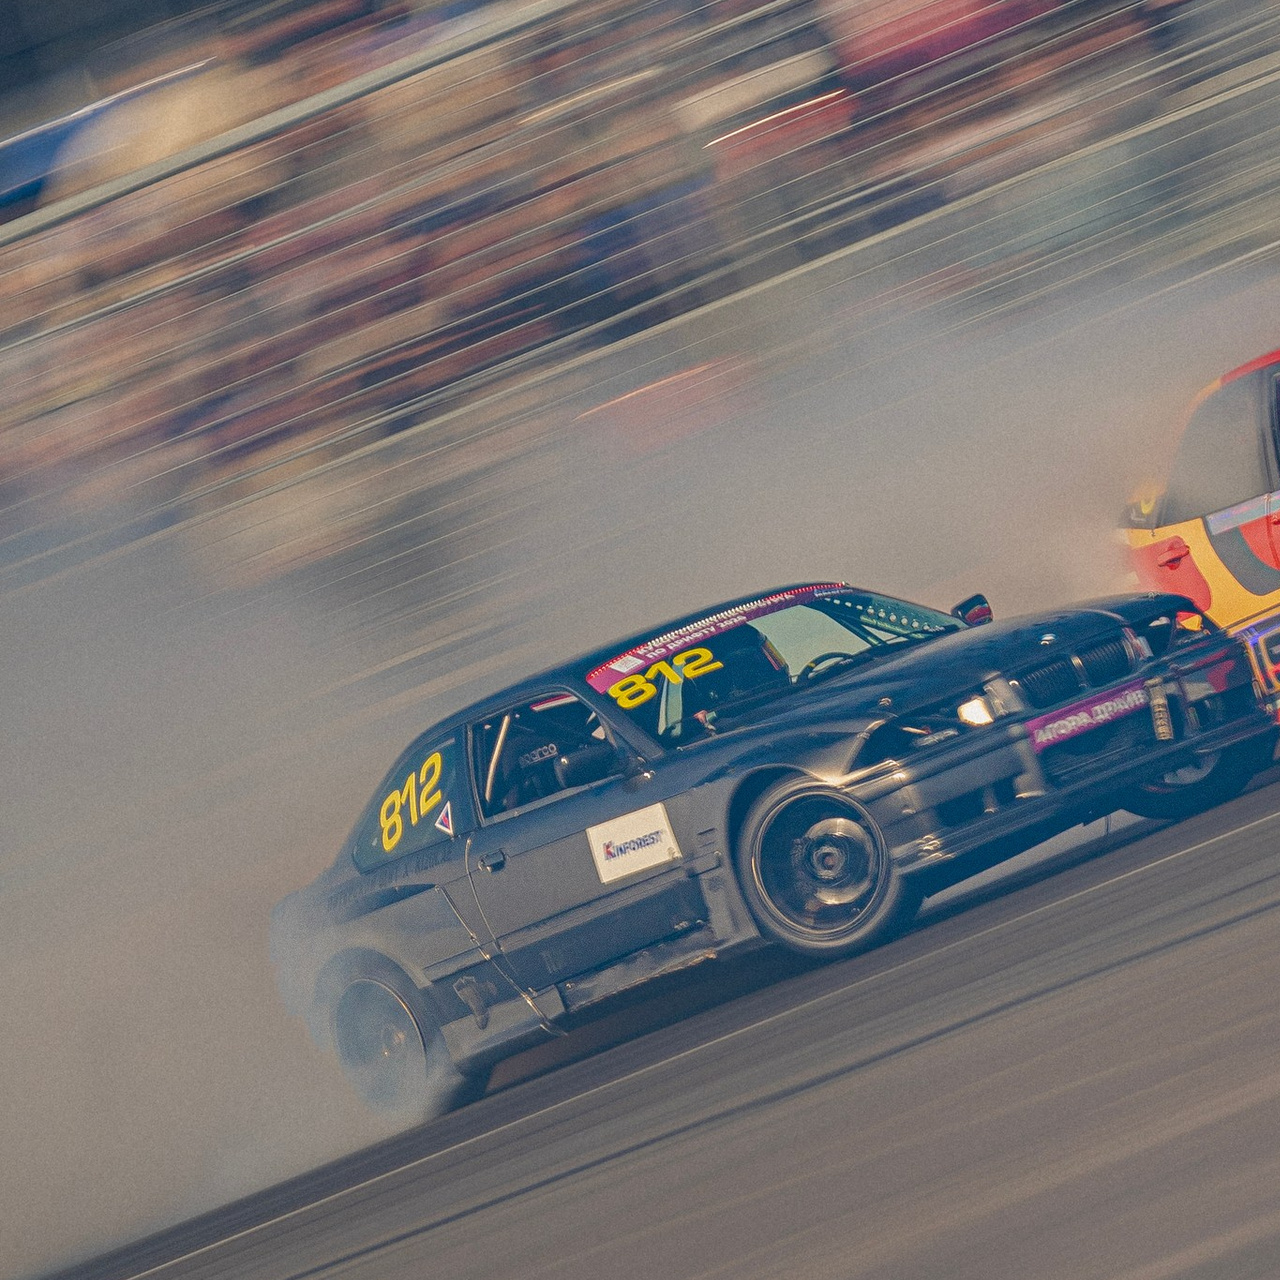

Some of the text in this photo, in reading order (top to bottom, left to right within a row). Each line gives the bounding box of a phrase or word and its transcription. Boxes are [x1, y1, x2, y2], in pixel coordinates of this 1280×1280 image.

[645, 648, 667, 660] ПО
[666, 626, 716, 650] ДРИФТУ
[607, 647, 724, 710] 812
[380, 752, 442, 853] 812
